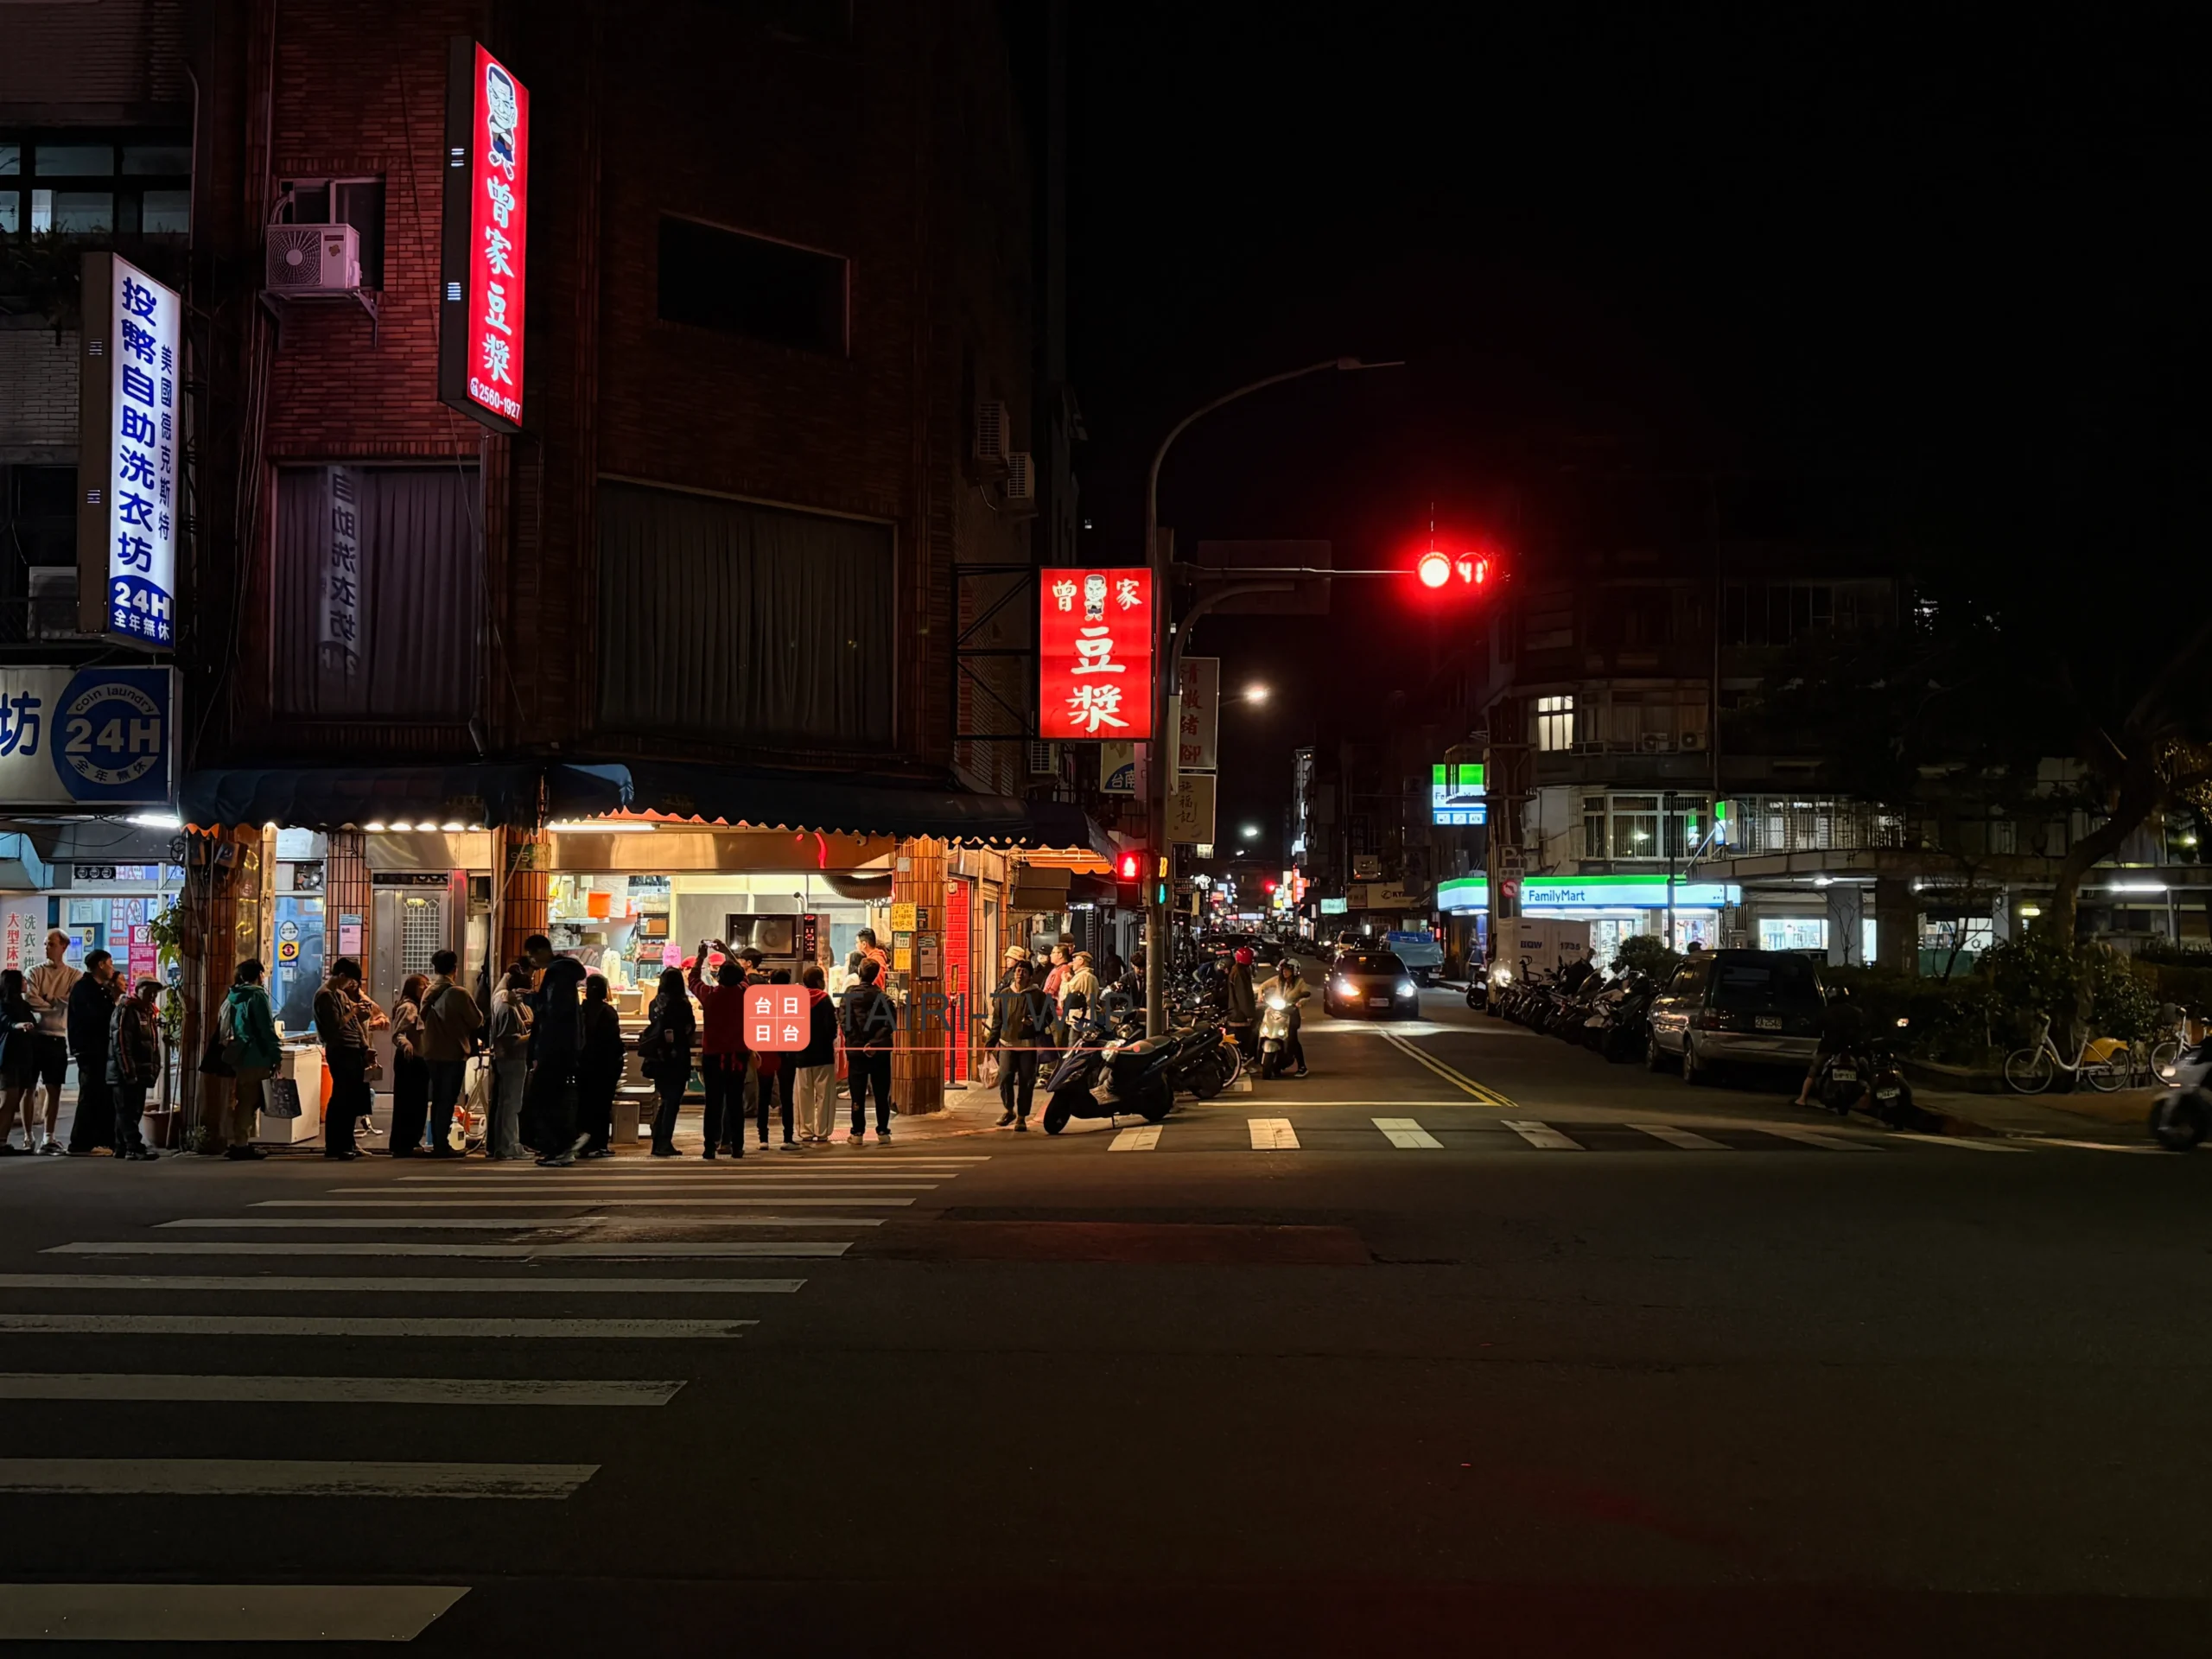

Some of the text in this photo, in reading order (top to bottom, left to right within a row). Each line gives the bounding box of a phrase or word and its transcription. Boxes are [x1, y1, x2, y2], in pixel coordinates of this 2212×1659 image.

[483, 175, 514, 385] 曾家豆漿
[479, 383, 521, 420] 2560-1927
[118, 276, 157, 573] 投幣自助洗衣坊
[115, 582, 170, 620] 24H
[114, 608, 170, 641] 全年無休
[75, 687, 155, 713] coin laundry
[65, 718, 161, 753] 24H
[74, 760, 147, 781] 全年無休
[1501, 848, 1517, 867] P
[1529, 889, 1586, 903] FamilyMart
